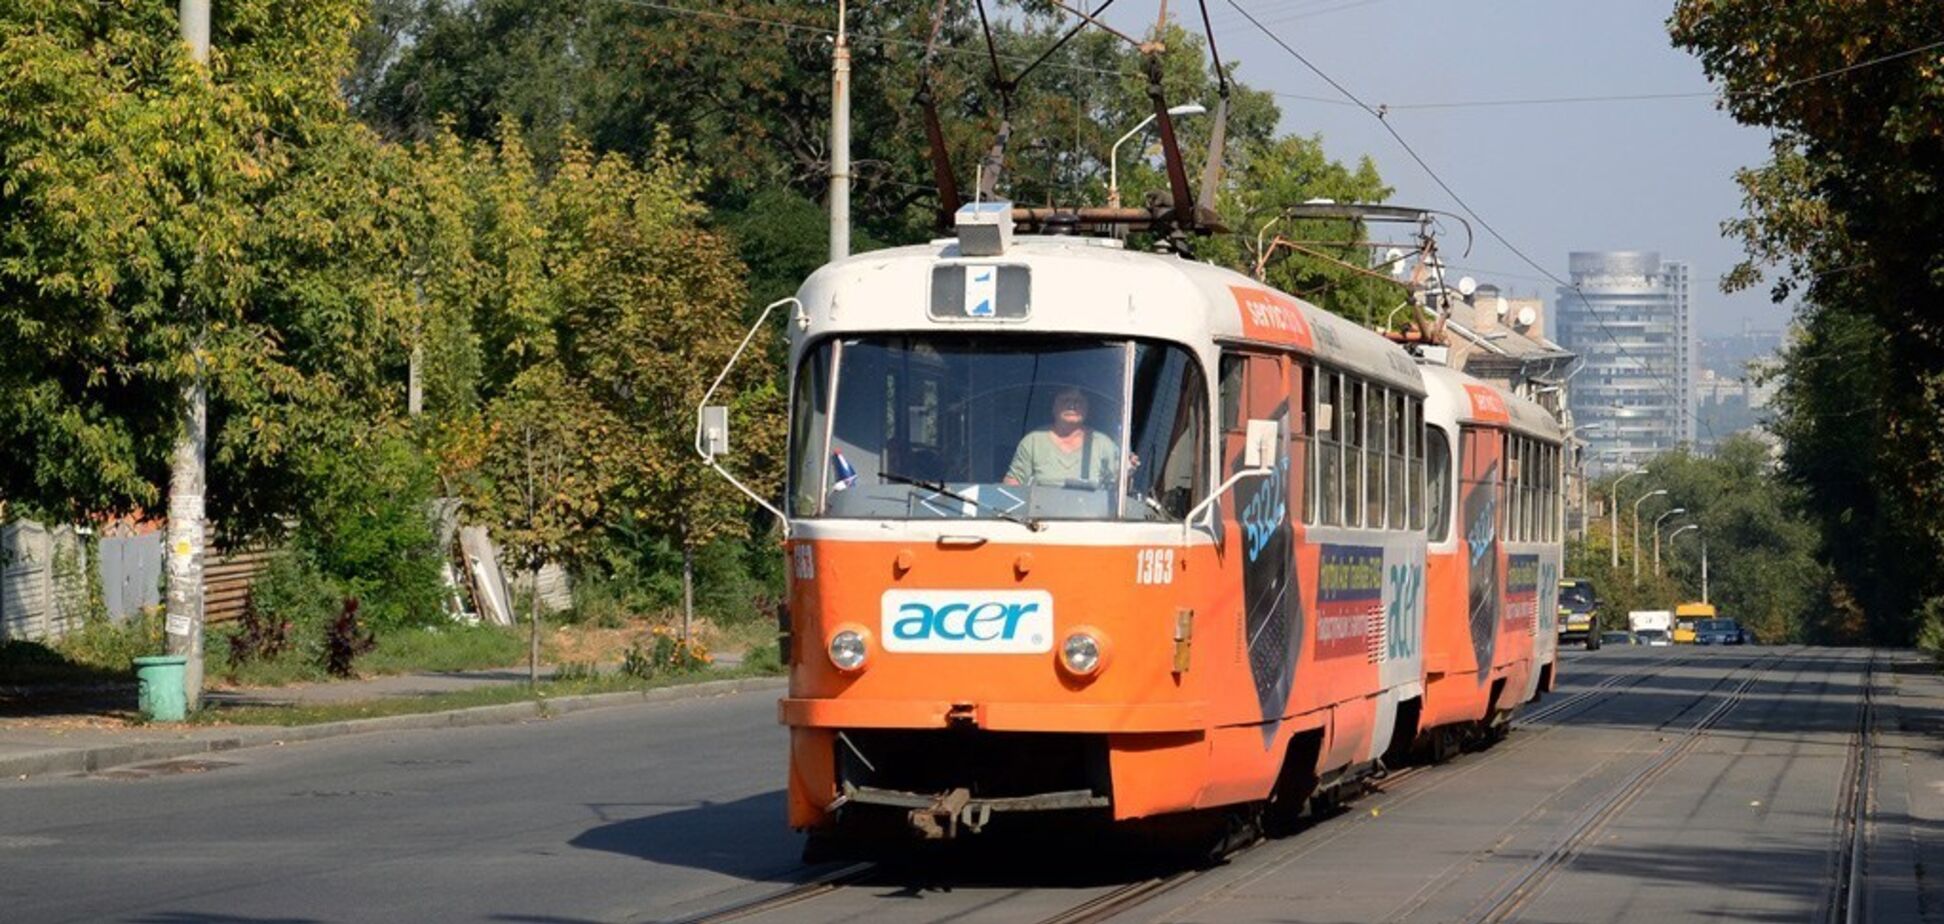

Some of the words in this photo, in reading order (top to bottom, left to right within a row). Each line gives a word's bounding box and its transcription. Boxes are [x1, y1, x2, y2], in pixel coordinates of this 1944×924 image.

[1136, 549, 1173, 584] 1363
[893, 602, 1039, 641] acer
[1389, 564, 1421, 659] acer
